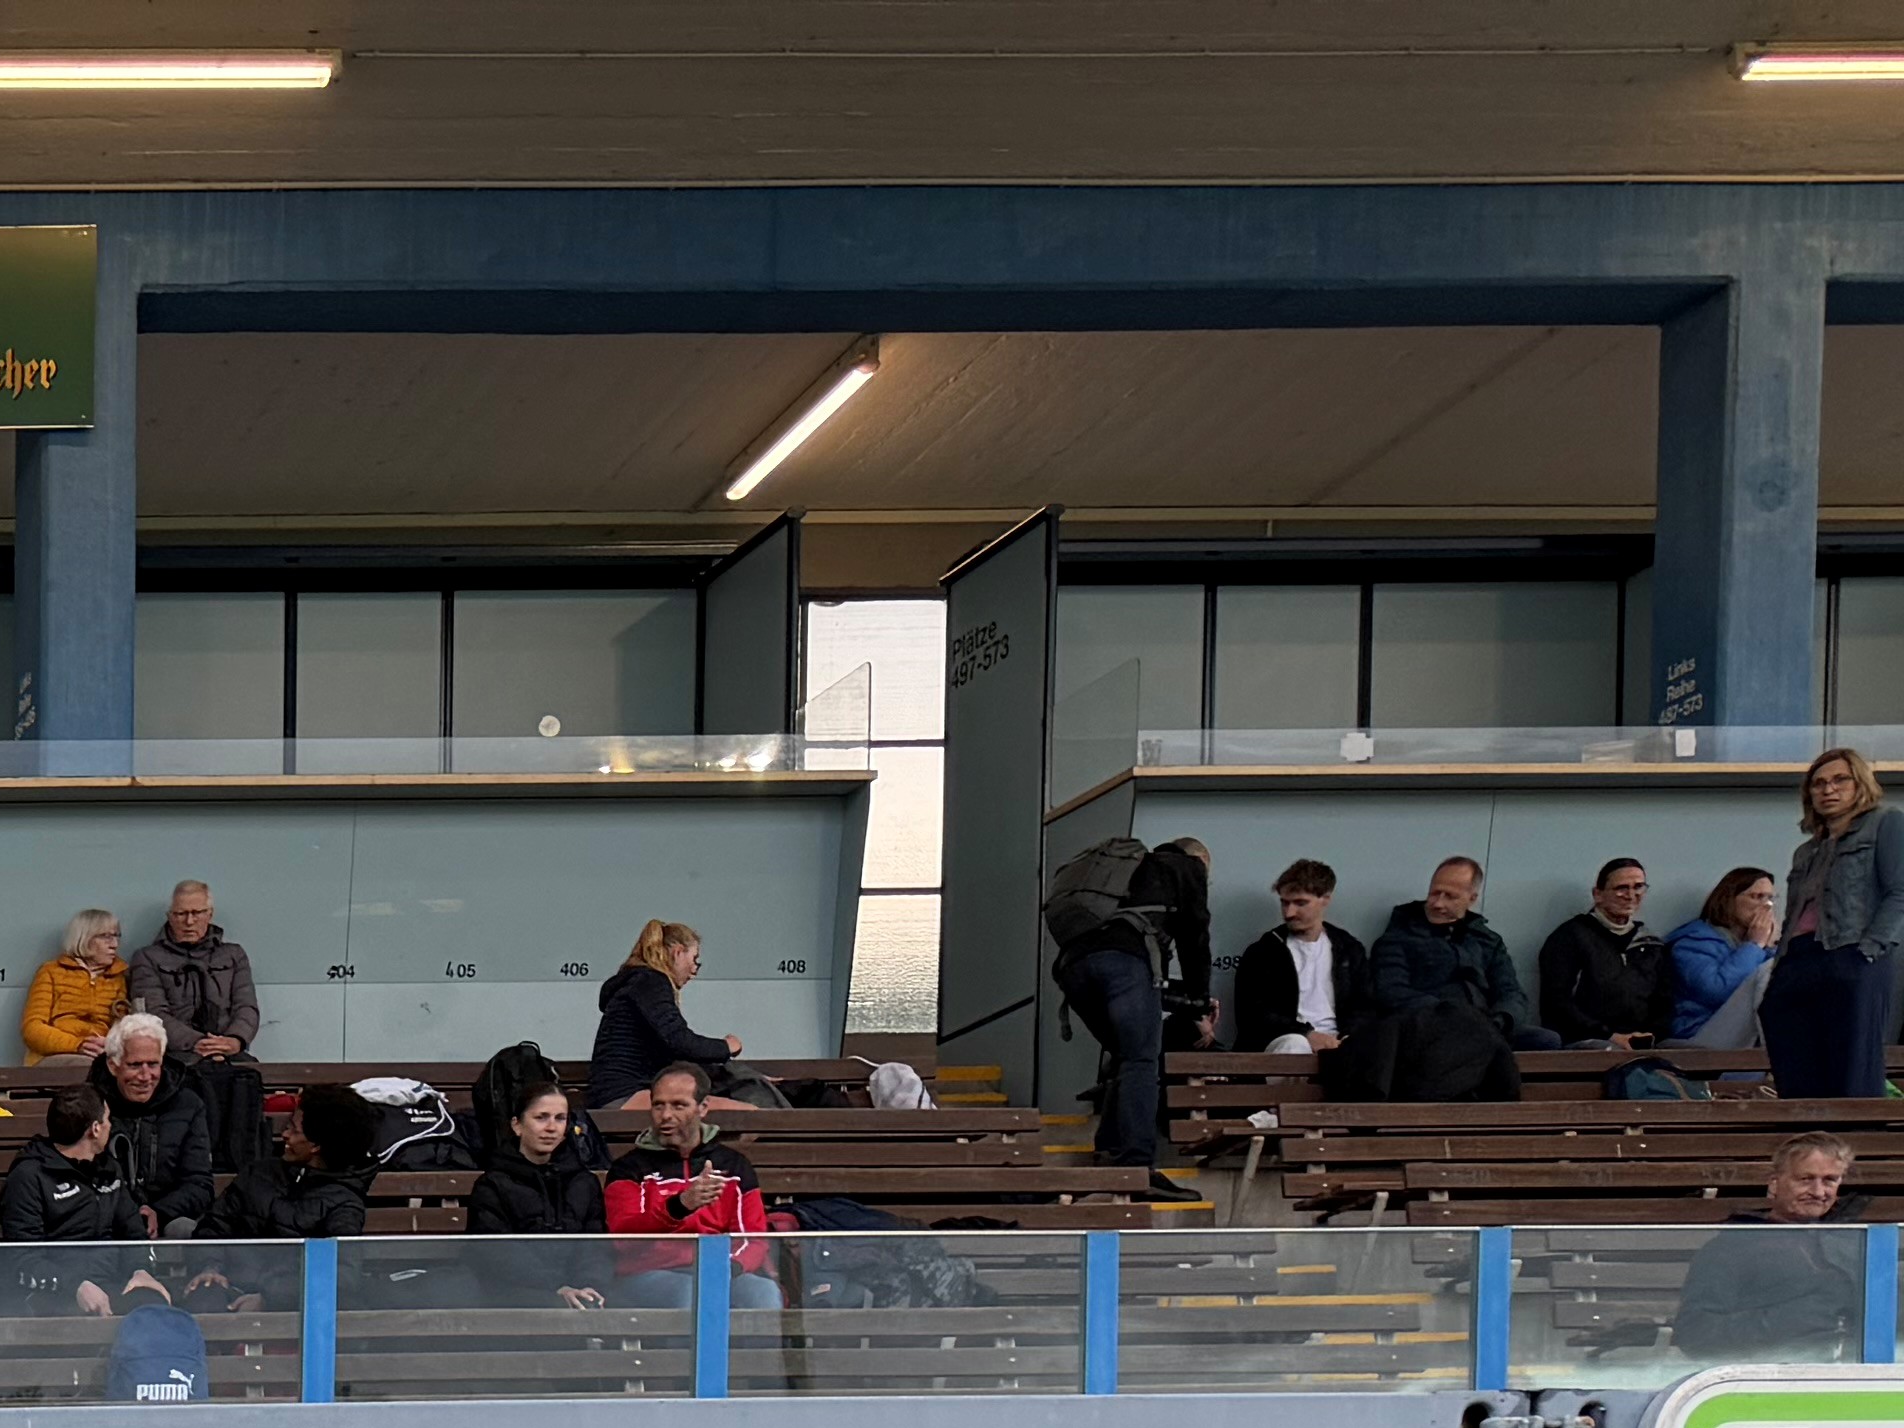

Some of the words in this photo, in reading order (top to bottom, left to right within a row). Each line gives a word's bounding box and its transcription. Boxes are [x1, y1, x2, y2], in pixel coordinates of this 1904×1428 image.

[952, 620, 998, 663] Plätze
[950, 633, 1010, 690] 497-573
[444, 961, 477, 979] 405
[559, 961, 590, 978] 406
[776, 958, 807, 975] 408
